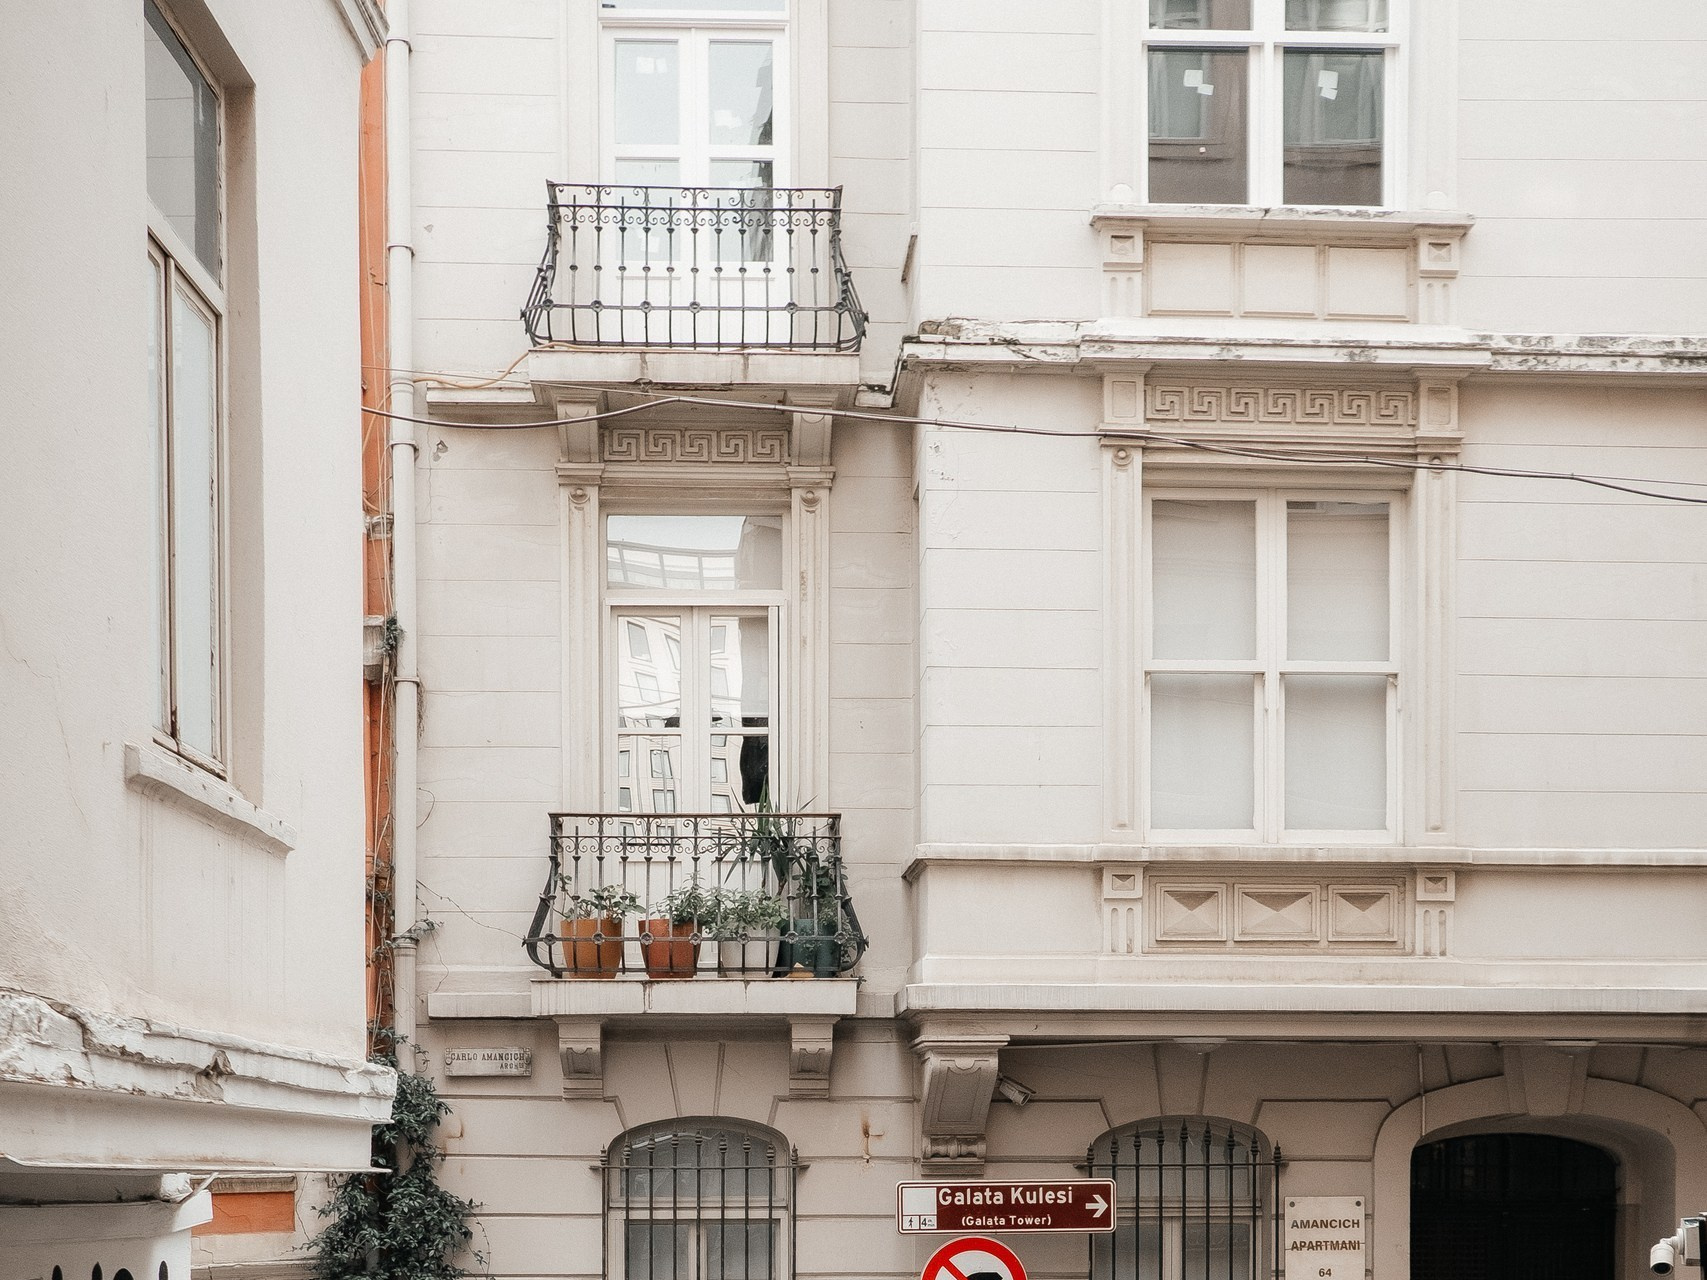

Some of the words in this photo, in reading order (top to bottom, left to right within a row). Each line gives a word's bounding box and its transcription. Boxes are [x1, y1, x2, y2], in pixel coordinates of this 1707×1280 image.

[450, 1053, 478, 1061] CARLO
[481, 1053, 525, 1061] AMANCICH
[938, 1187, 1004, 1206] Galata
[1011, 1186, 1073, 1205] Kulesi
[921, 1217, 927, 1227] 4
[961, 1215, 1006, 1227] (Galata
[1009, 1214, 1052, 1226] Tower)
[1291, 1219, 1360, 1229] AMANCICH
[1291, 1240, 1361, 1251] APARTMANI
[1318, 1268, 1332, 1277] 64
